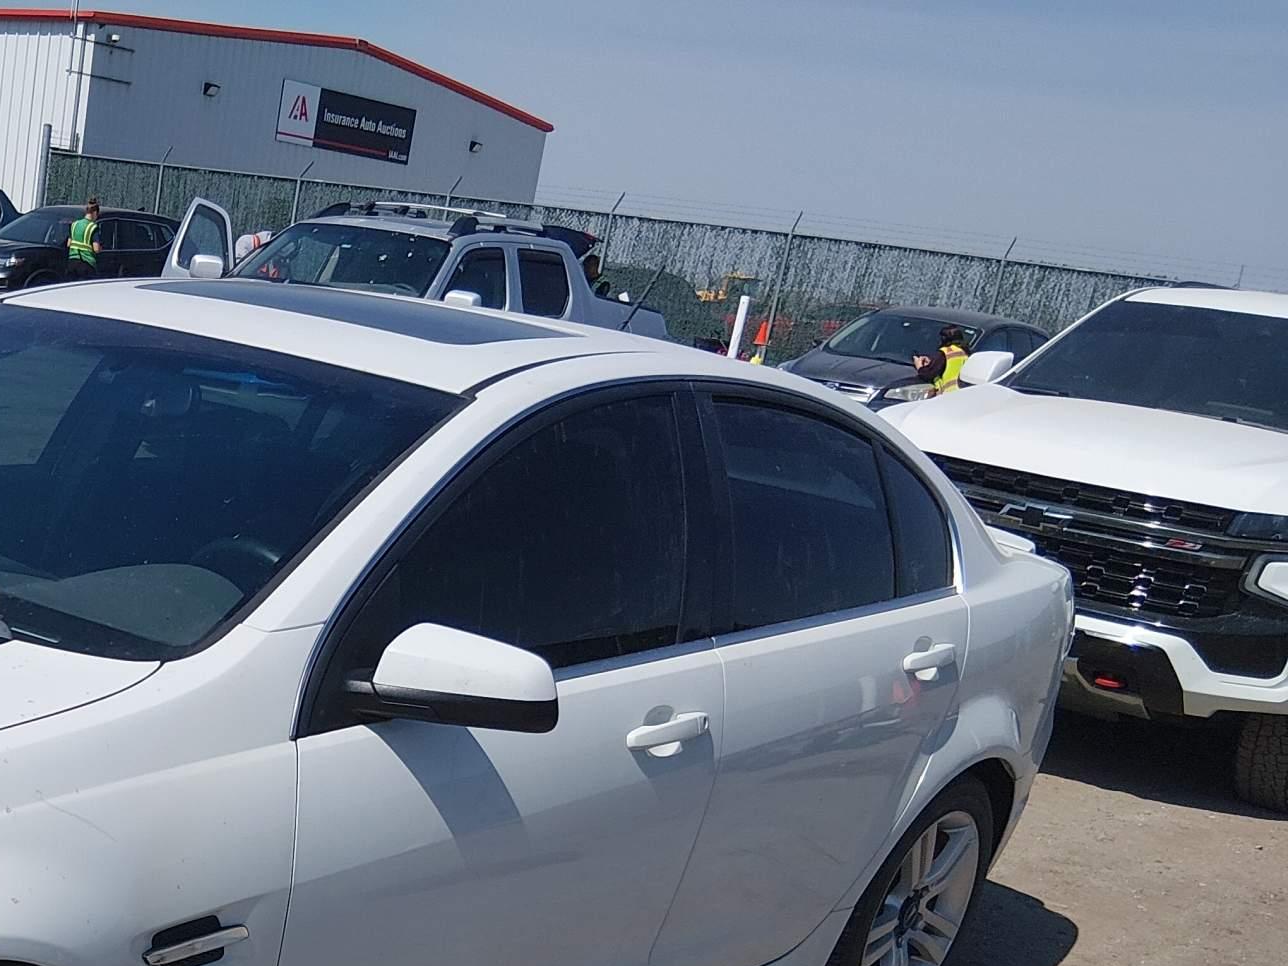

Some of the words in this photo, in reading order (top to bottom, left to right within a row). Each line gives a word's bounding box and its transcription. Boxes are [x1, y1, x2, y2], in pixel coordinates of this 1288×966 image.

[323, 108, 359, 129] Insurance
[359, 116, 376, 132] Auto
[376, 120, 407, 139] Auctions
